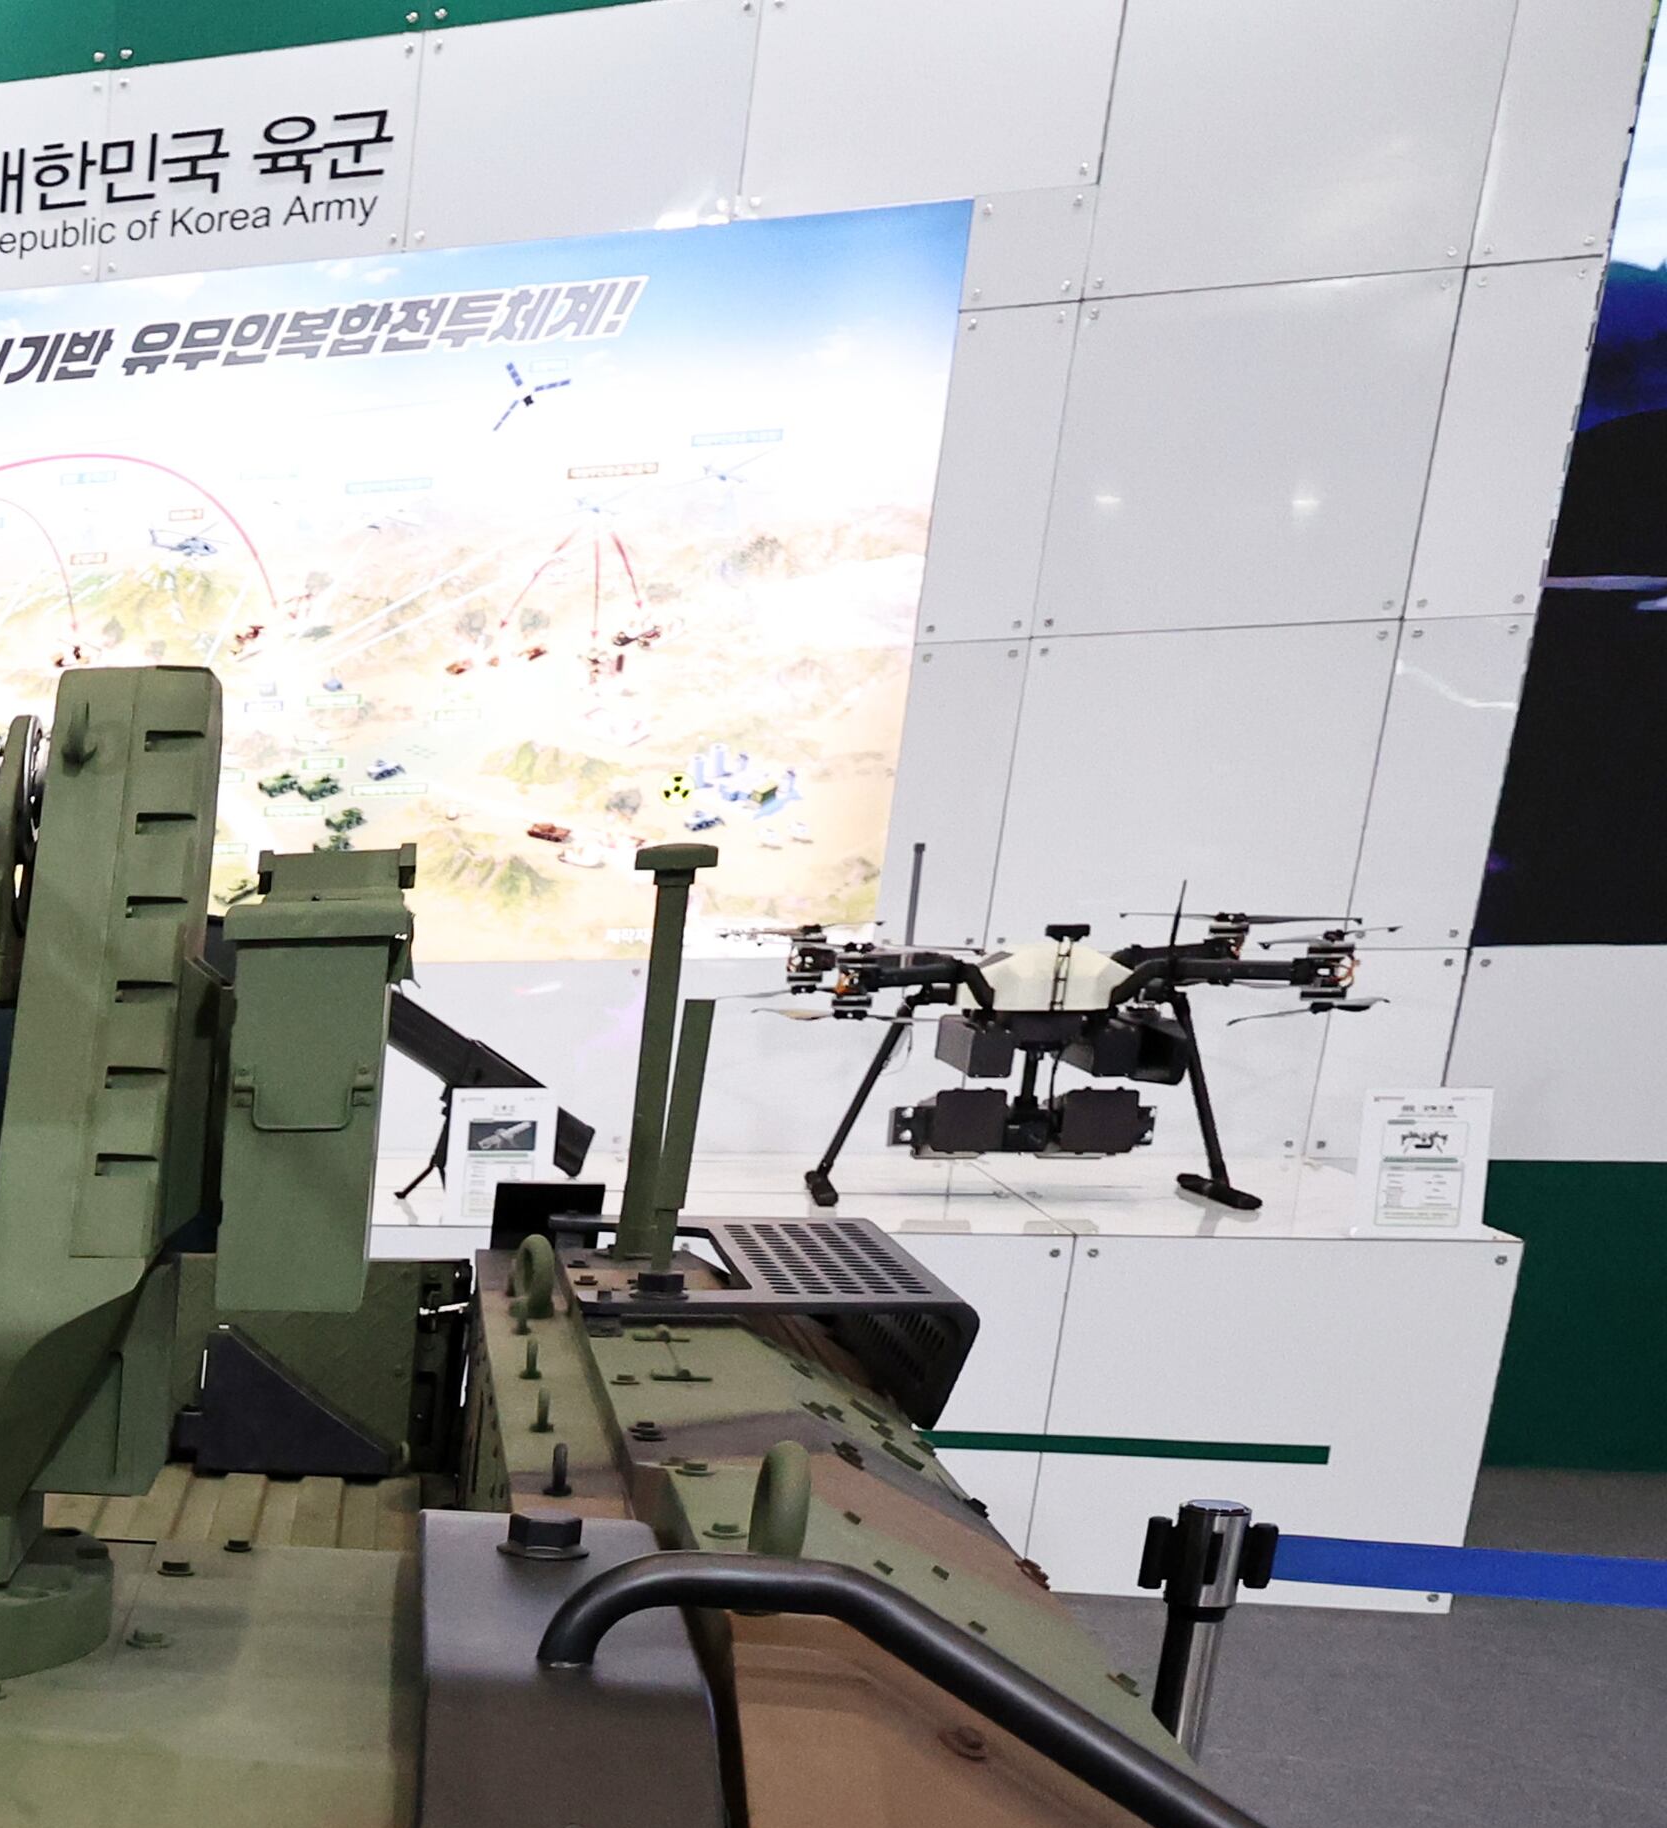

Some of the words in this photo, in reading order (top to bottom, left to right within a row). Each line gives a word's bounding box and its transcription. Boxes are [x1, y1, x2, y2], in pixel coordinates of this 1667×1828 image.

[253, 109, 394, 185] 육군
[126, 208, 159, 240] of
[170, 203, 270, 236] Korea
[283, 192, 378, 227] Army
[121, 276, 647, 377] 유무인복합전투체계!
